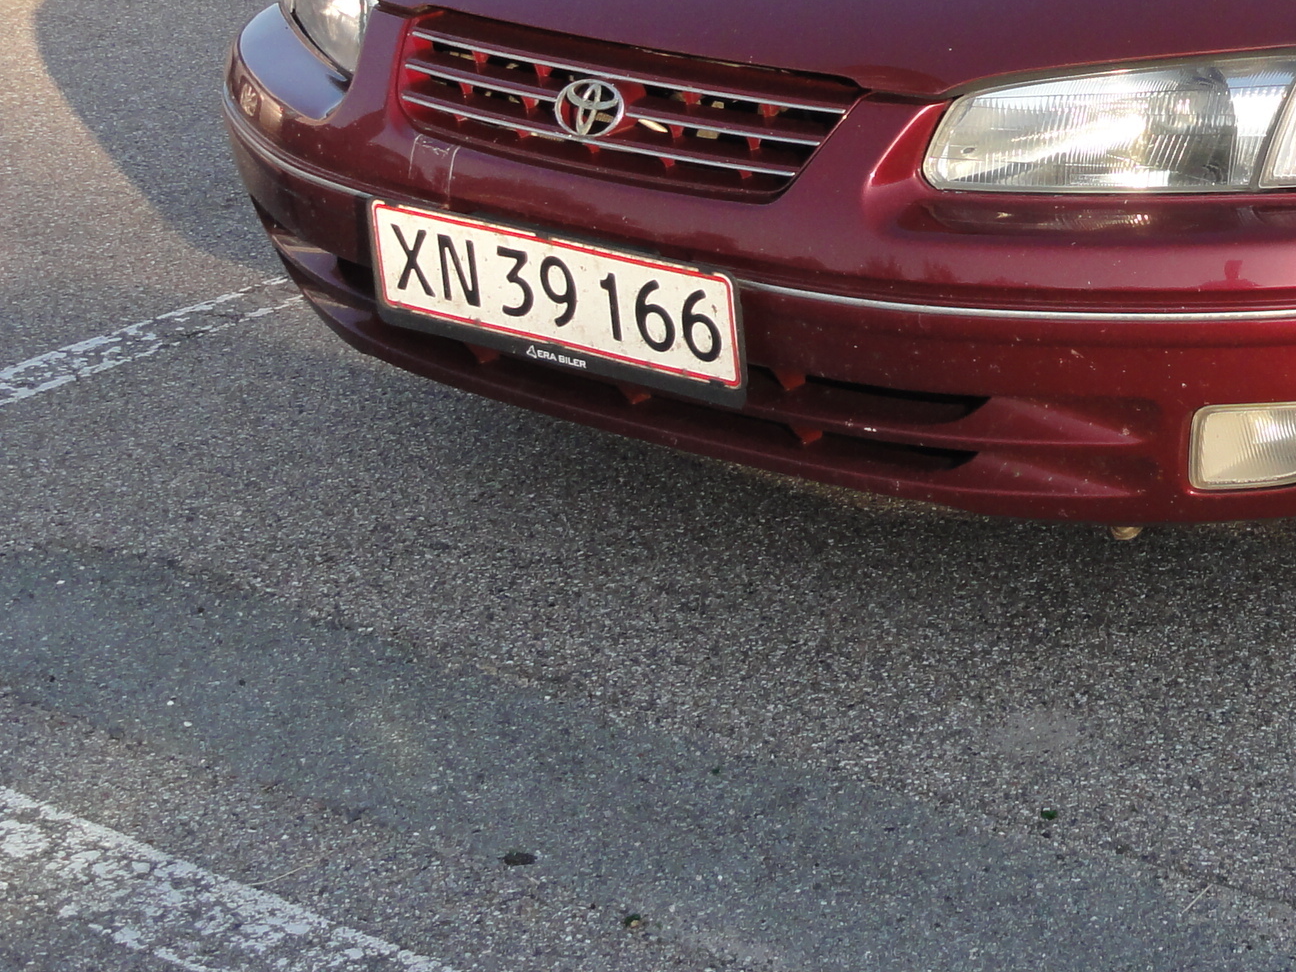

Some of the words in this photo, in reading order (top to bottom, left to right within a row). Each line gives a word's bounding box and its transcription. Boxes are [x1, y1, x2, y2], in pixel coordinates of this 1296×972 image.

[391, 223, 482, 308] XN
[496, 245, 578, 328] 39
[600, 272, 723, 363] 166
[557, 354, 587, 369] BILER
